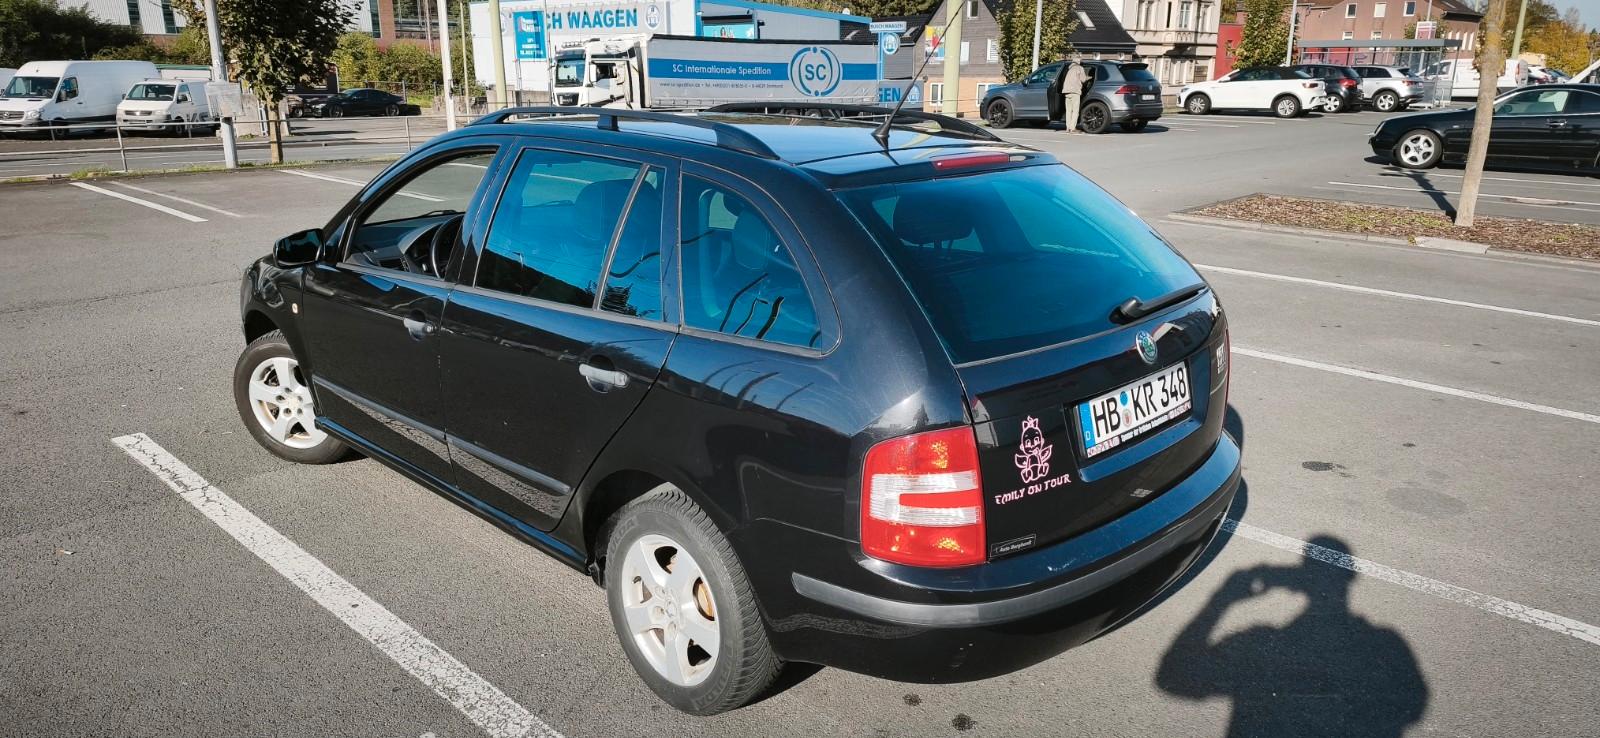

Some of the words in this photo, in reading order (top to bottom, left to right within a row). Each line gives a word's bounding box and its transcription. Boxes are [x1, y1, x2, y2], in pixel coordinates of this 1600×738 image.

[568, 8, 638, 29] WAAGEN
[672, 63, 683, 73] SC
[685, 64, 737, 75] Internationale
[739, 66, 772, 76] Spedition
[805, 63, 827, 81] SC
[1092, 396, 1121, 439] HB
[1130, 384, 1158, 421] KR
[1157, 367, 1187, 408] 348
[994, 487, 1026, 505] EMILY
[1027, 483, 1043, 496] ON
[1044, 473, 1072, 491] TOUR
